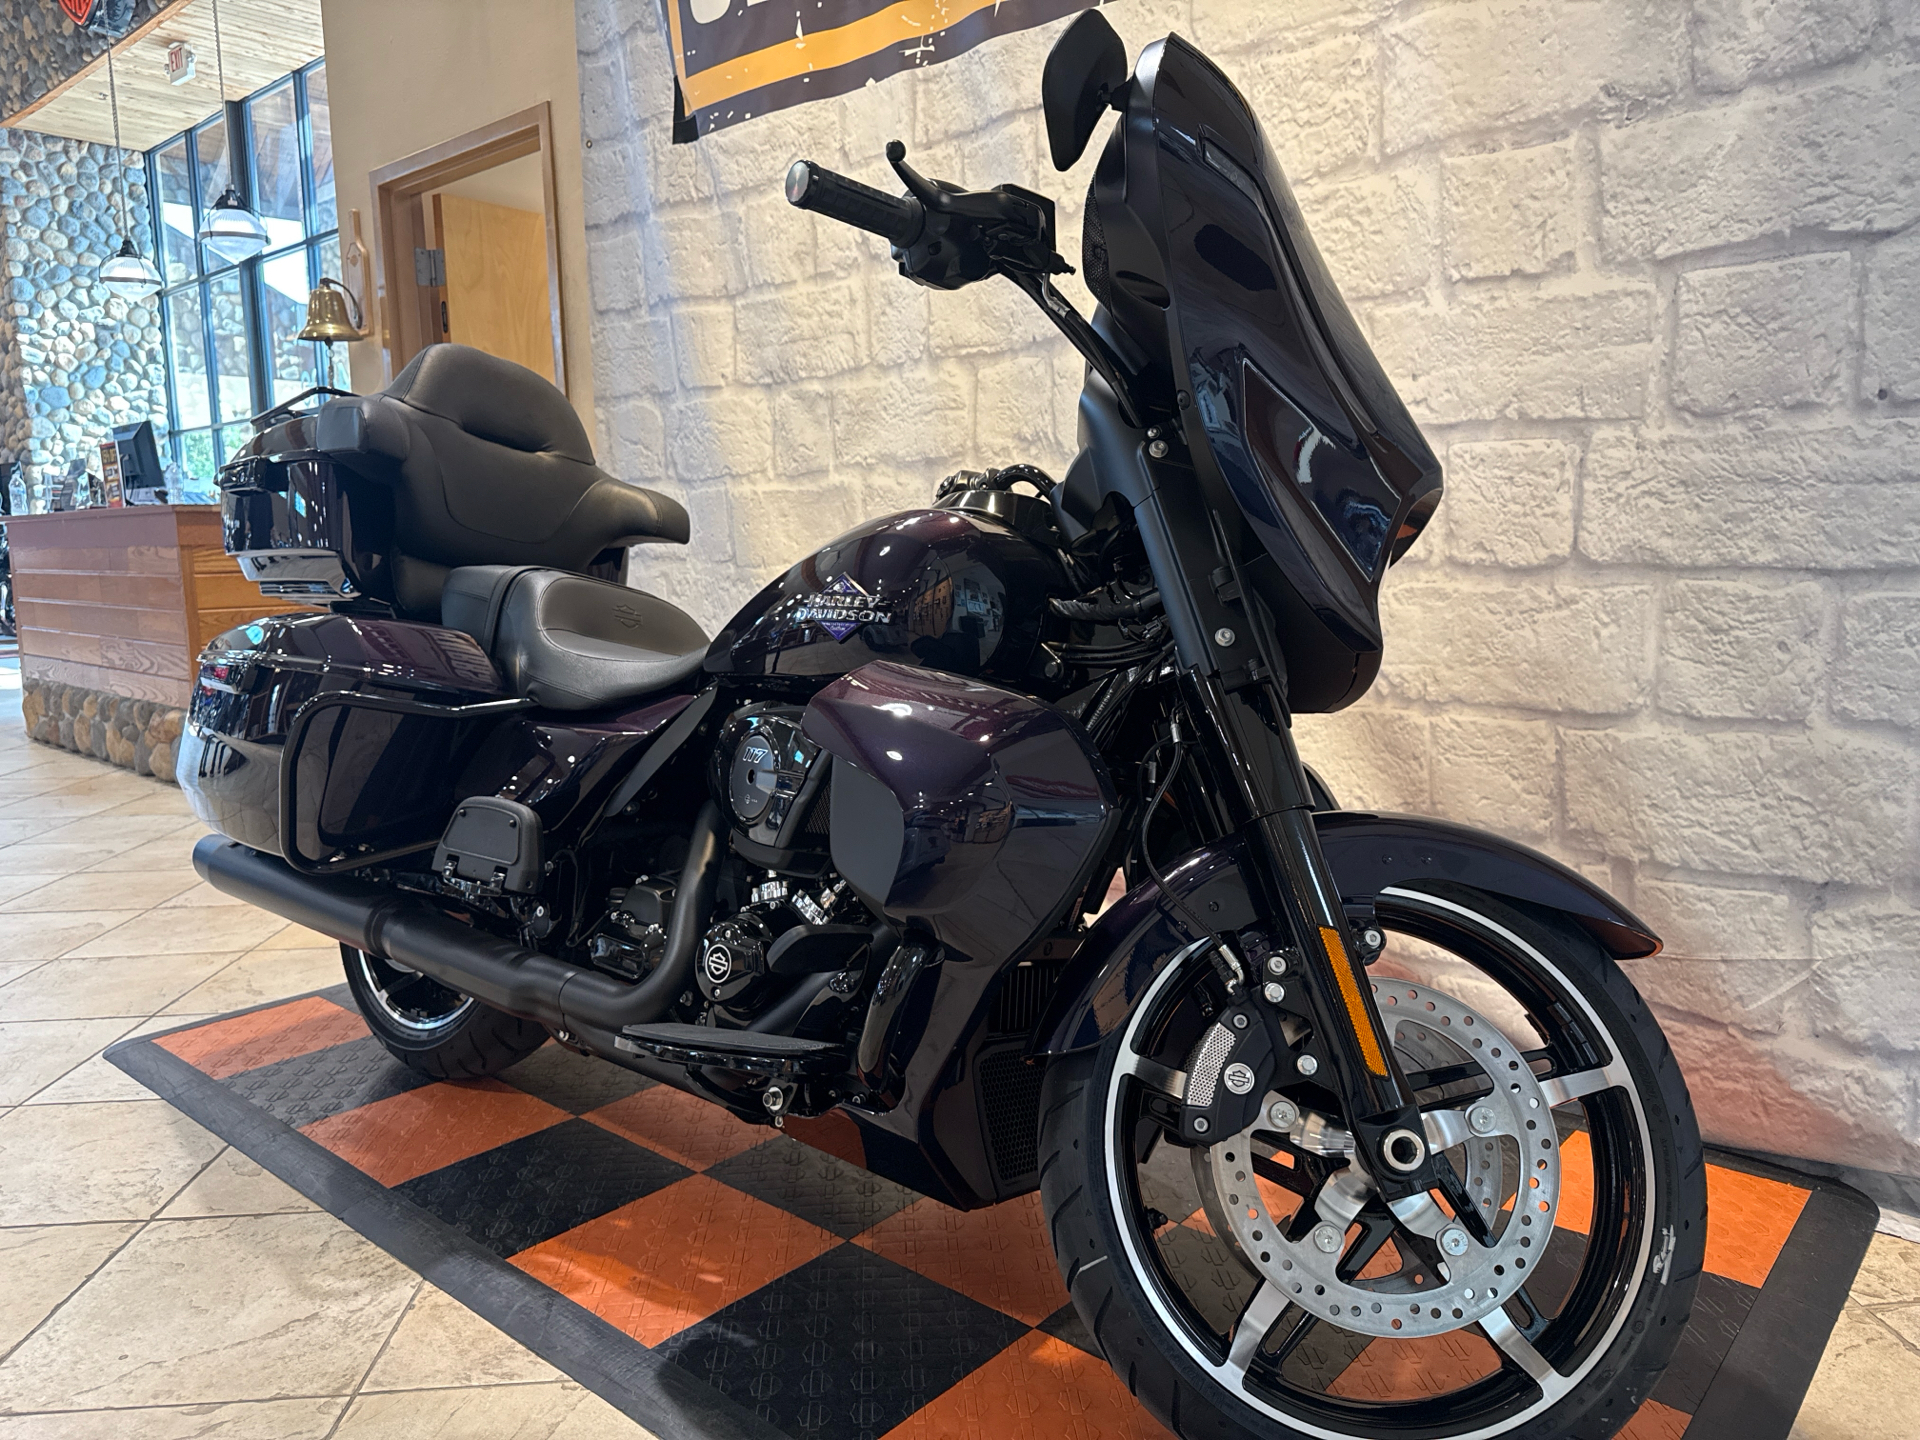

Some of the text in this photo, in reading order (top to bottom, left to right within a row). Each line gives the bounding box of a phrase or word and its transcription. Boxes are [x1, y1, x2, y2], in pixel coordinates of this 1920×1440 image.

[170, 47, 183, 72] EXIT
[795, 607, 892, 623] DAVIDSON
[743, 747, 768, 763] 117
